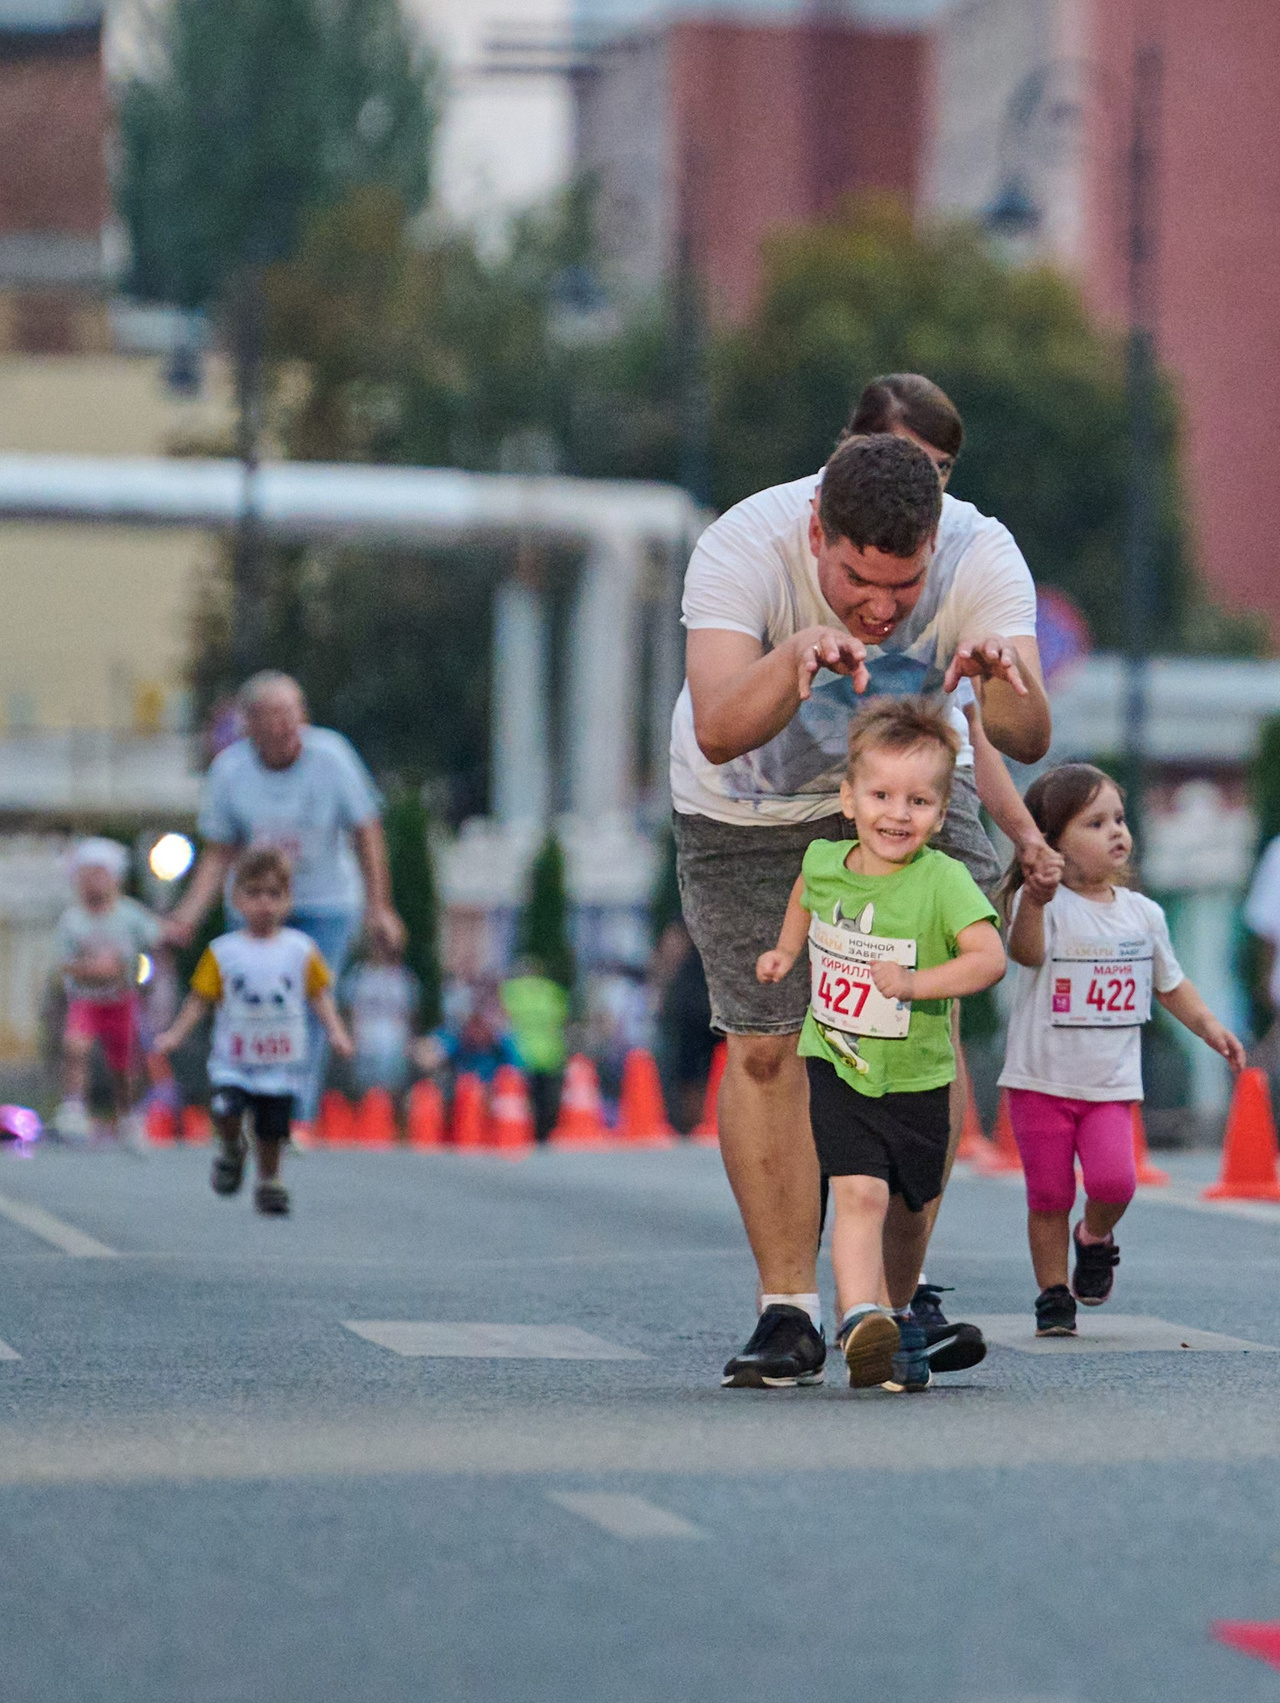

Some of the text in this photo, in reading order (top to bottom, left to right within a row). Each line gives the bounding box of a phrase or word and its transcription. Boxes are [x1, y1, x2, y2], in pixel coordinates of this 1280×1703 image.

[848, 938, 895, 952] НОЧНОЙ
[848, 948, 883, 959] ЗАБЕГ
[821, 956, 871, 979] КИРИЛЛ
[1093, 965, 1132, 975] МАРИЯ
[817, 971, 871, 1018] 427
[1085, 978, 1136, 1012] 422
